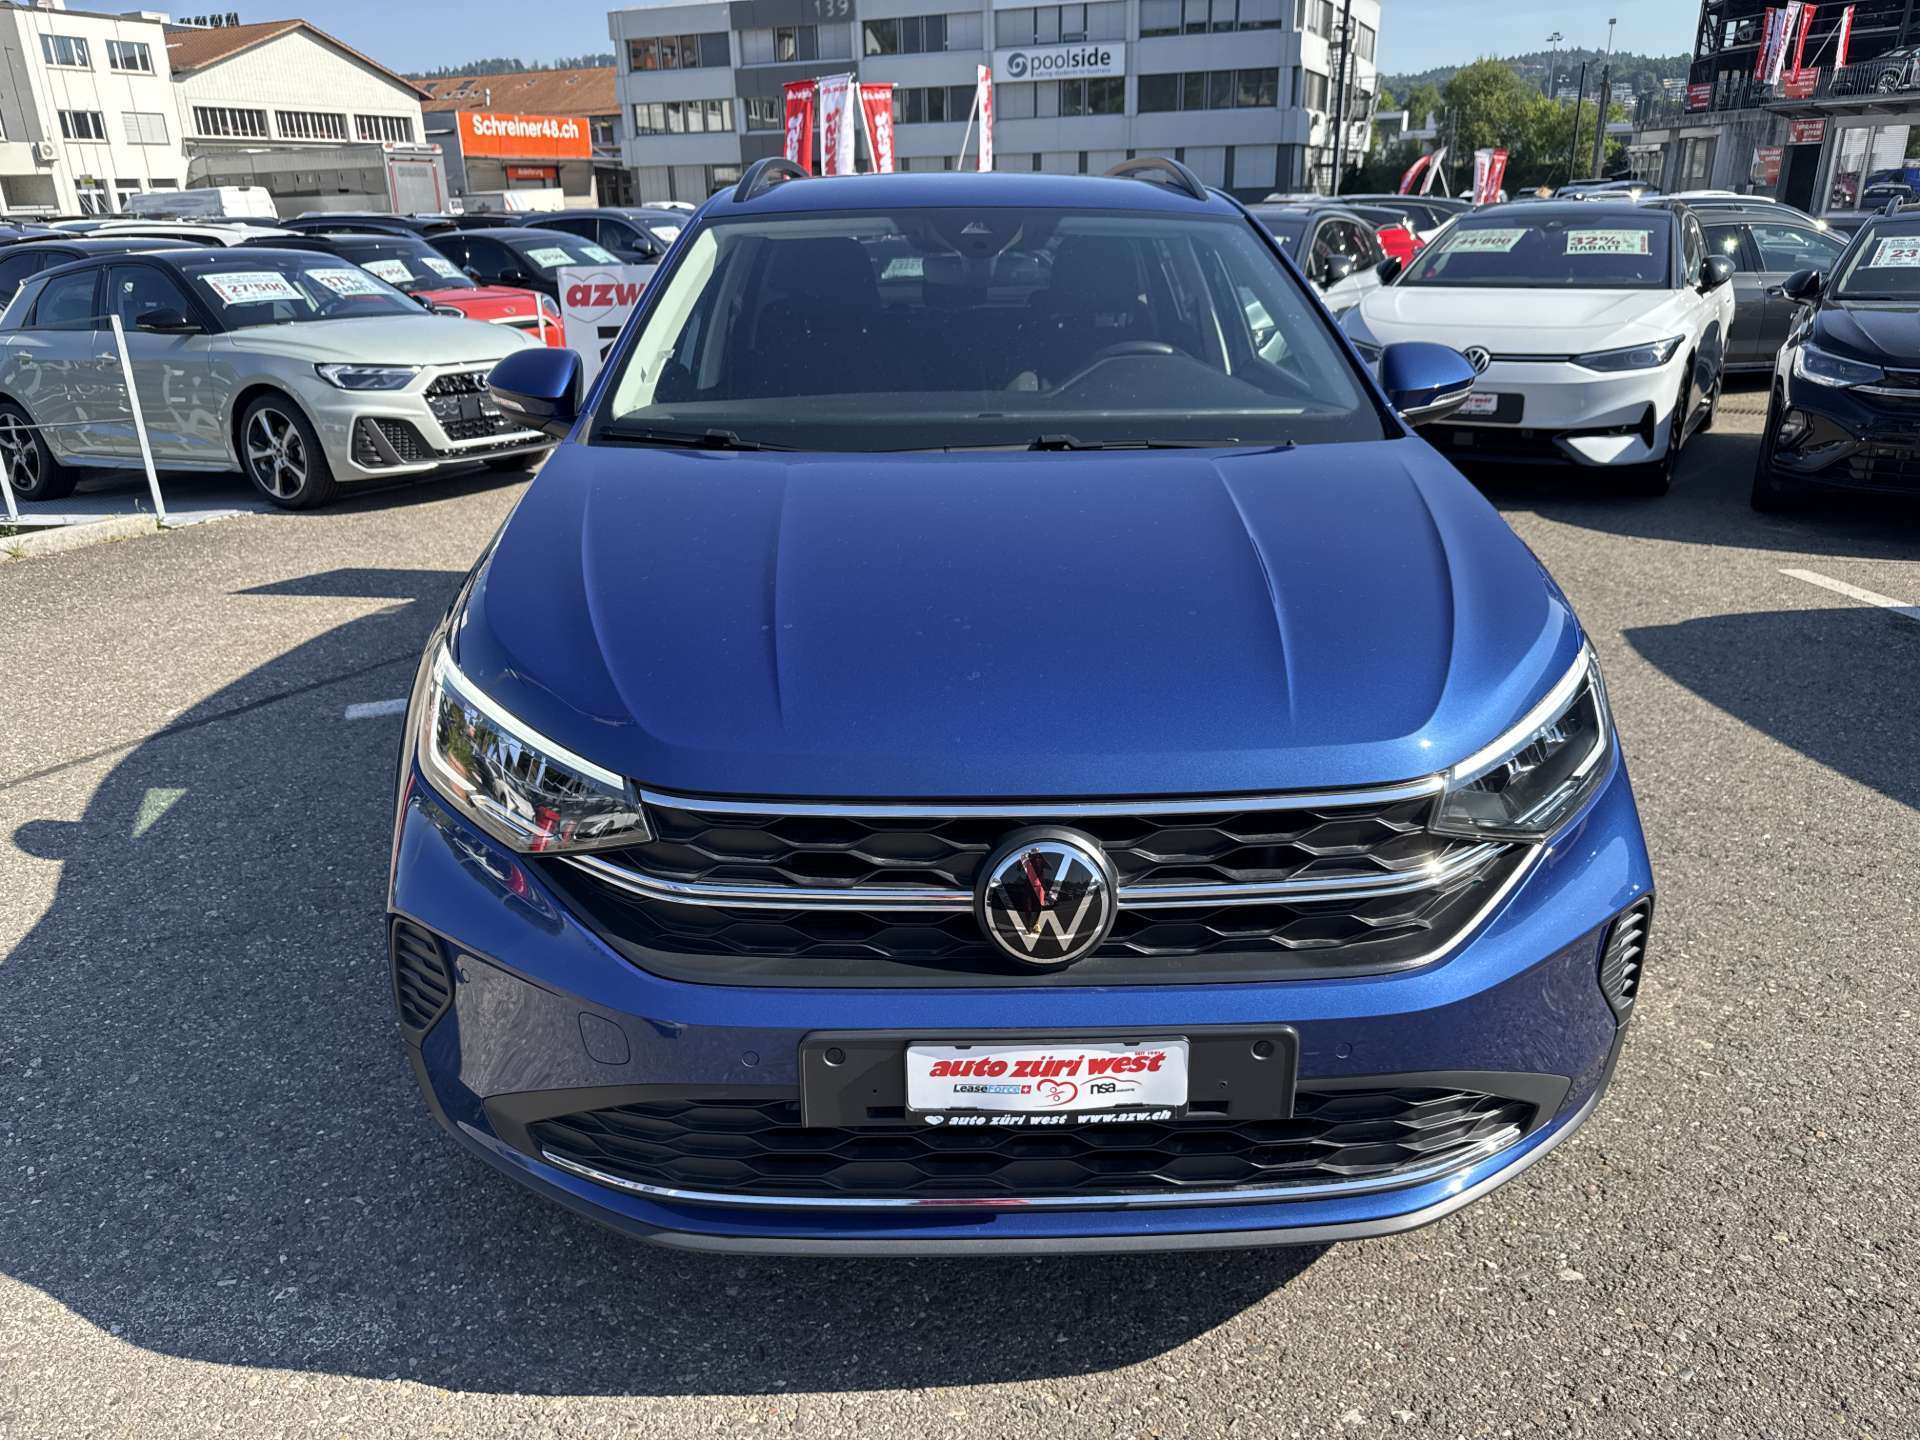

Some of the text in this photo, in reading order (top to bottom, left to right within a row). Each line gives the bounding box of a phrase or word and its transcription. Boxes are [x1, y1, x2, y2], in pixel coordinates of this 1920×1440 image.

[814, 0, 849, 17] 139
[1030, 47, 1111, 77] poolside
[472, 114, 580, 139] Schreiner48.ch
[566, 283, 646, 307] azw
[929, 1052, 1167, 1077] auto züri west
[1090, 1083, 1116, 1094] nsa
[949, 1110, 1171, 1125] auto züri west www.azw.ch
